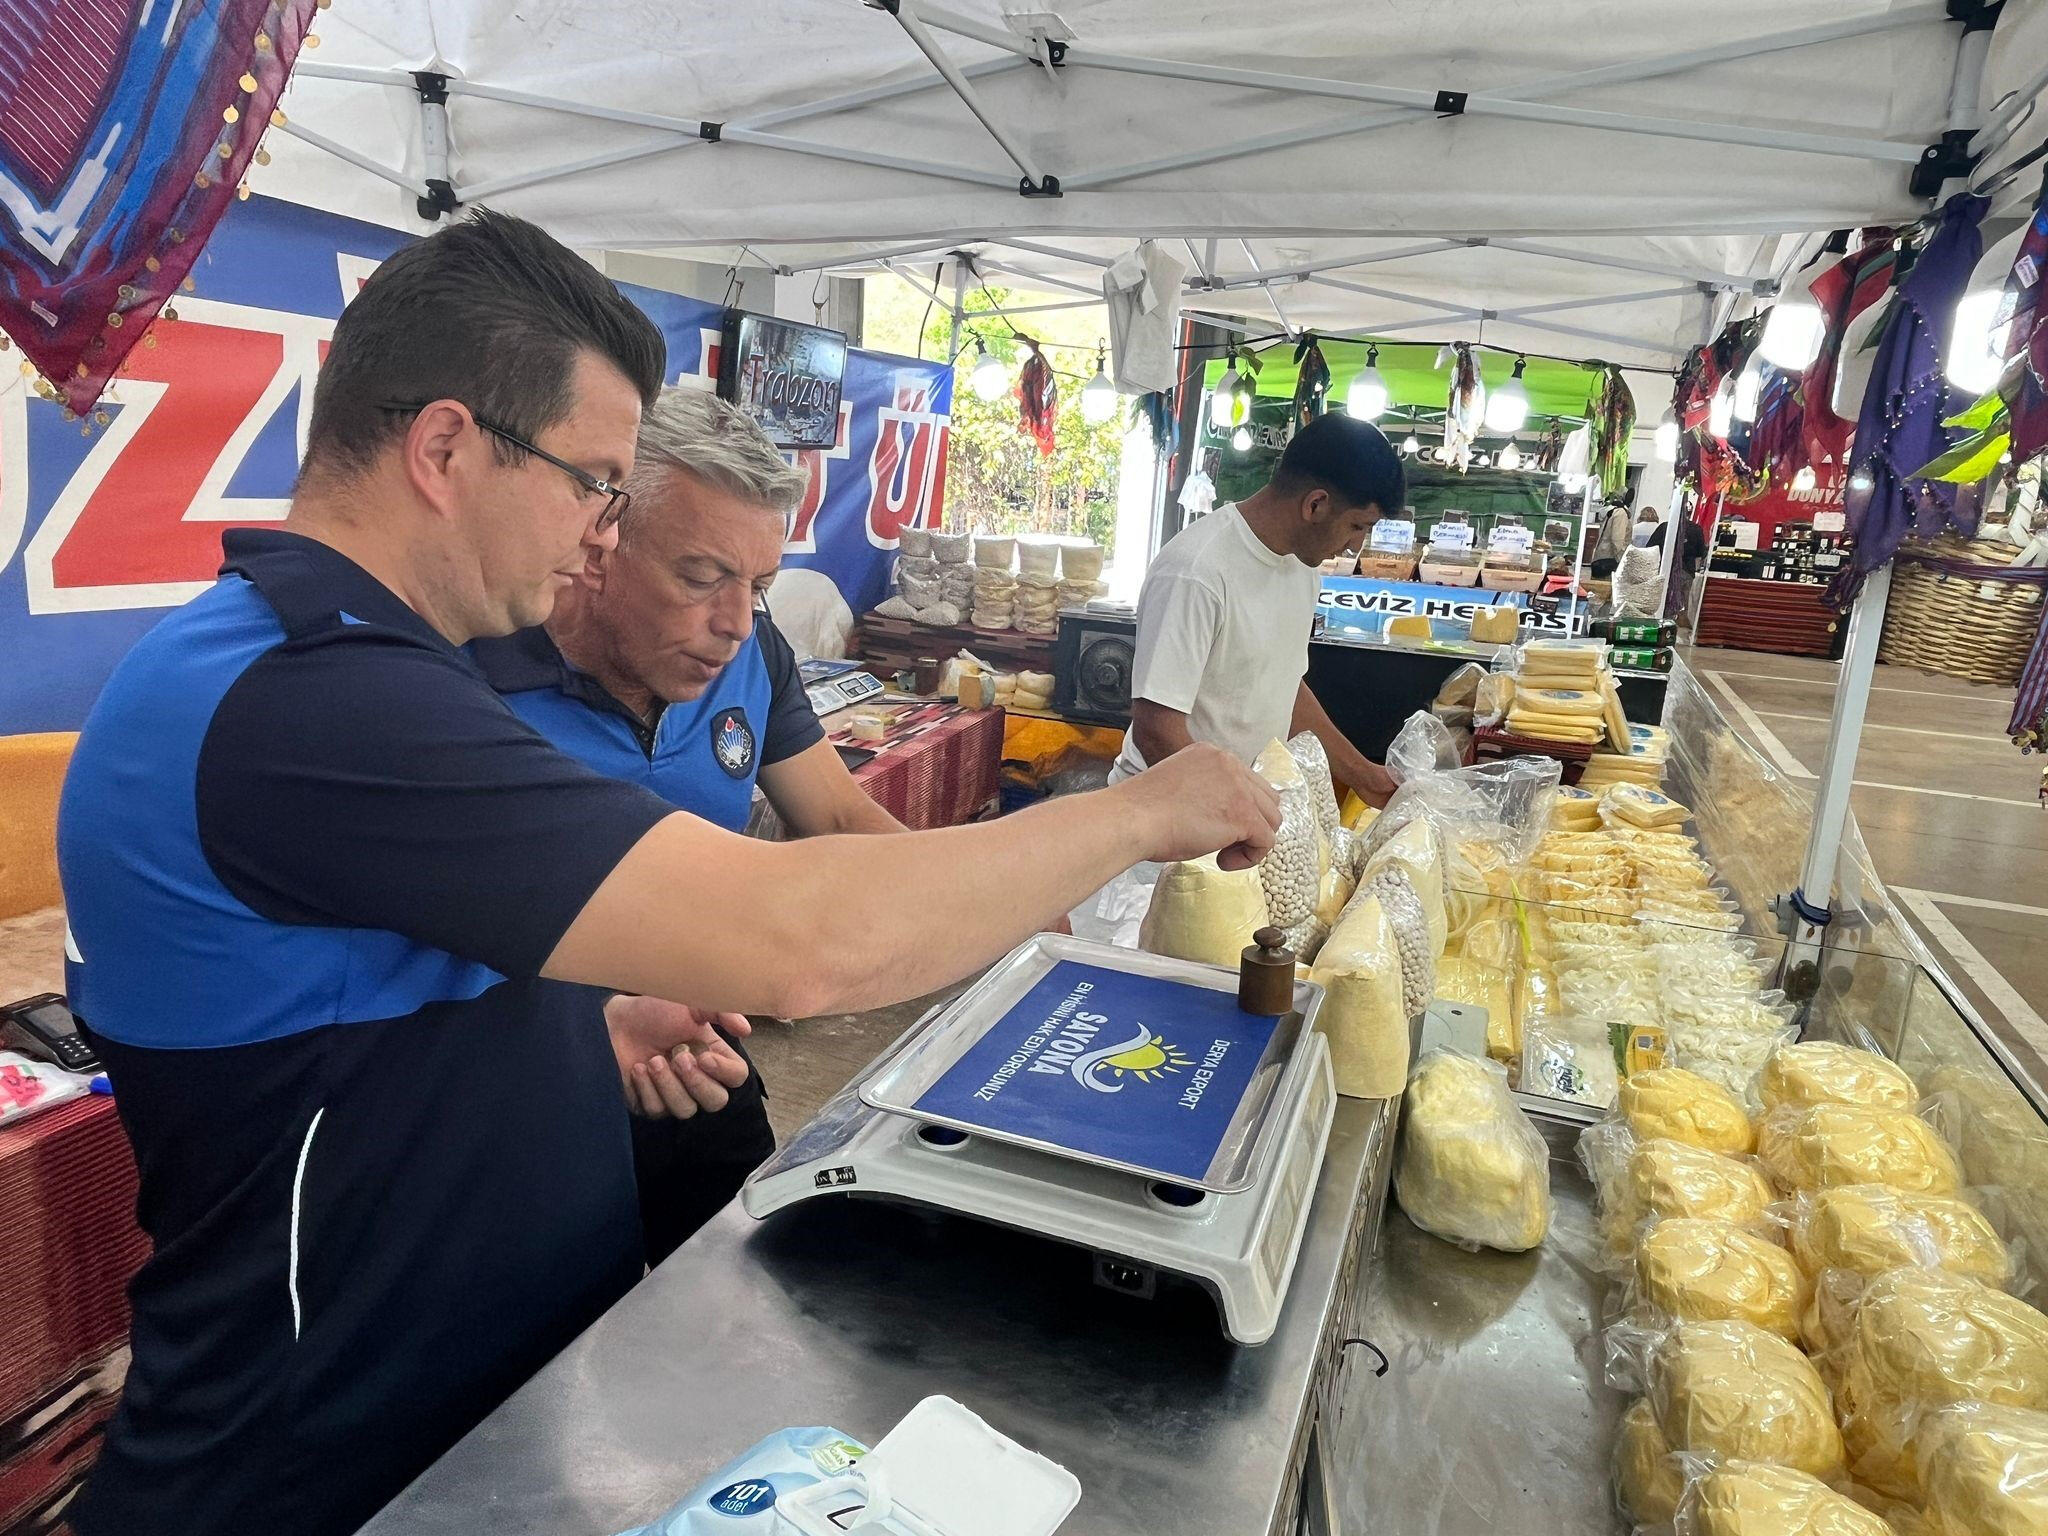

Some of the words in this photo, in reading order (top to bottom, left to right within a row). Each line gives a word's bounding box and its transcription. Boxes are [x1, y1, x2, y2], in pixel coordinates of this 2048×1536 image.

[744, 353, 838, 413] Trabzon
[1072, 982, 1094, 994] EN
[1027, 1011, 1108, 1075] SAYONA
[1036, 1017, 1063, 1041] HAK
[973, 1035, 1046, 1102] EDİYORSUNUZ
[1199, 1038, 1231, 1071] DERYA
[1178, 1067, 1214, 1110] EXPORT
[720, 1499, 749, 1514] adet
[727, 1483, 769, 1503] 101
